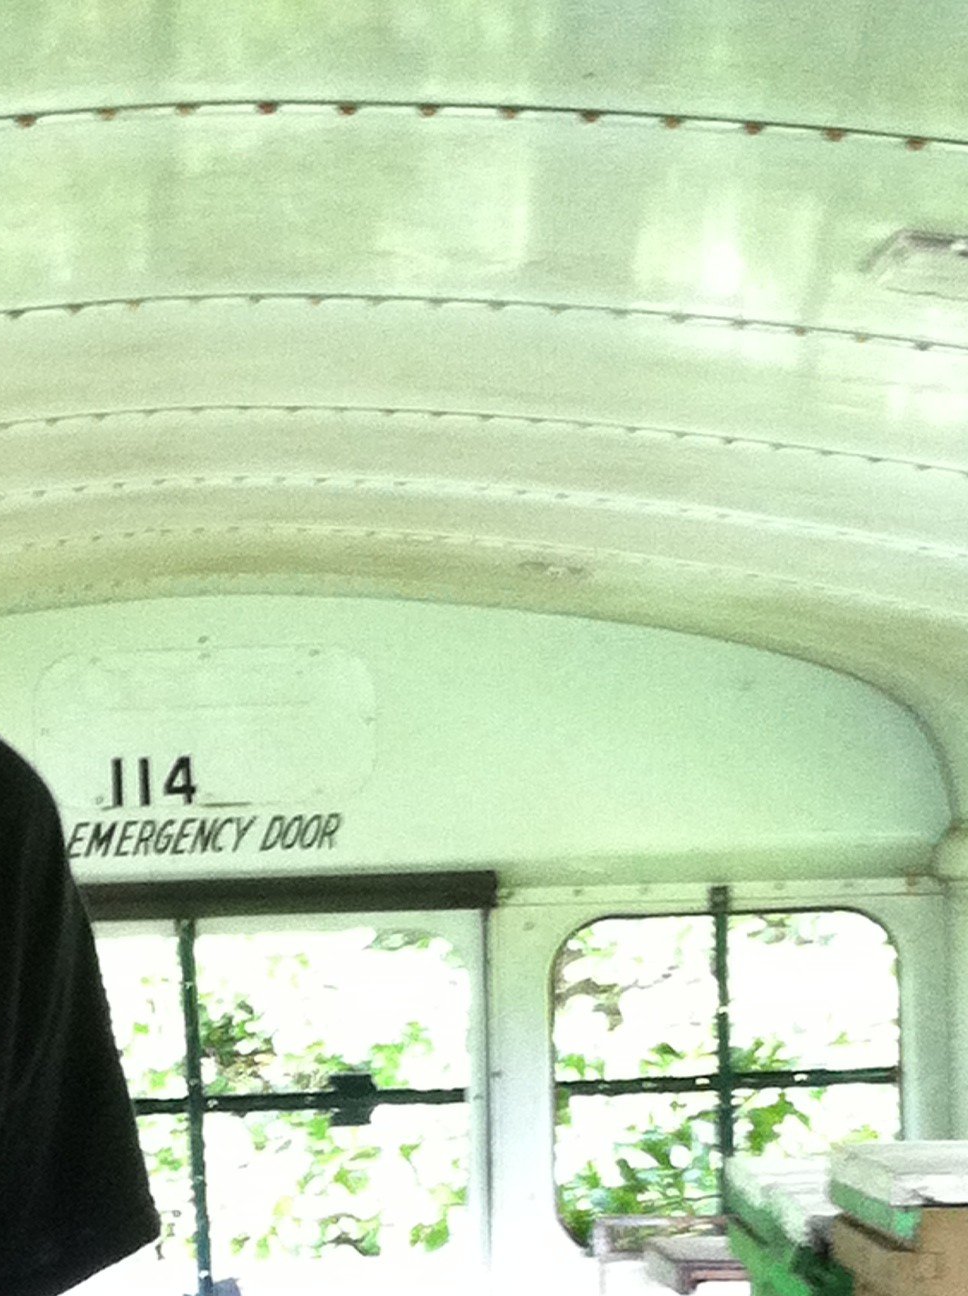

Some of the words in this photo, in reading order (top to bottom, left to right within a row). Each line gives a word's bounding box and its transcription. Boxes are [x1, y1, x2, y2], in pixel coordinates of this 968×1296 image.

[111, 755, 197, 808] 114
[68, 815, 257, 859] EMERGENCY
[259, 812, 342, 852] DOOR
